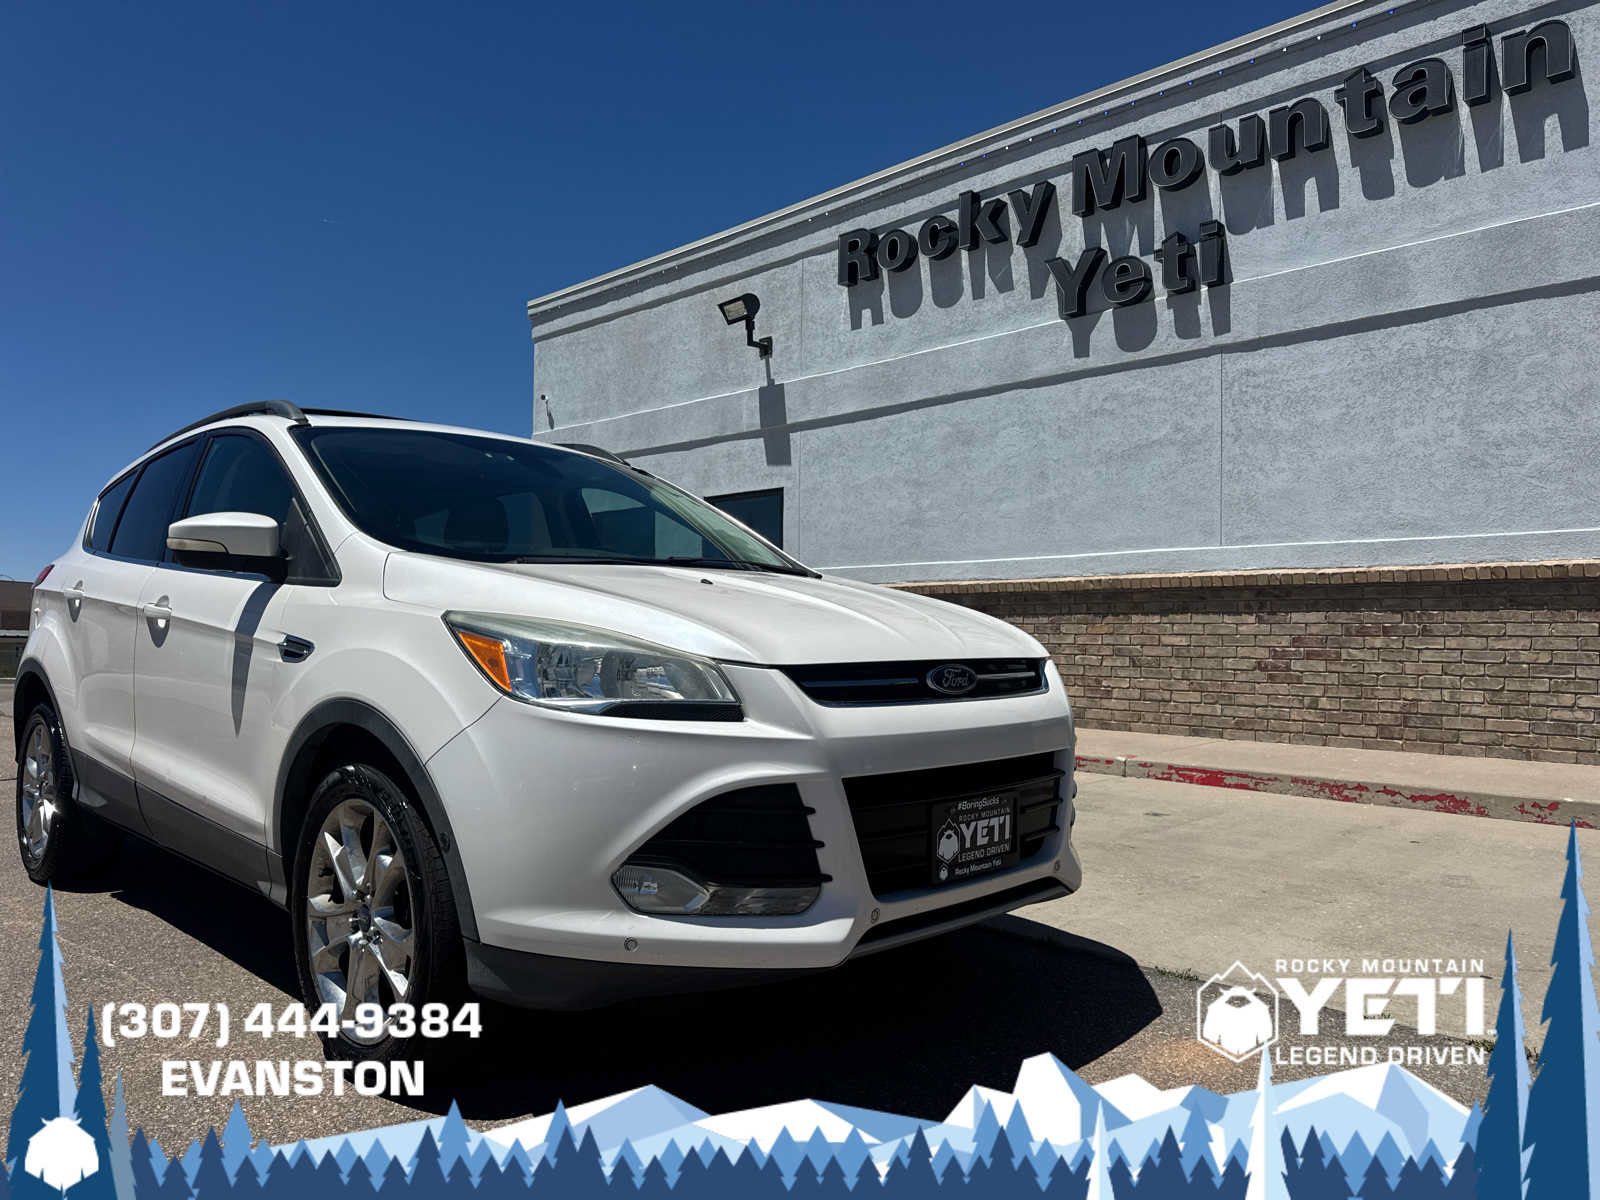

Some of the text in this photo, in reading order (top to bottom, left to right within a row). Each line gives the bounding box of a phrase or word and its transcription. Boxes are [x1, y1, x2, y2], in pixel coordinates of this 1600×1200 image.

[837, 19, 1576, 287] Rocky Mountain
[1046, 219, 1233, 318] Yeti
[942, 668, 969, 688] Ford
[959, 808, 1010, 822] ROCKY MOUNTAIN
[960, 814, 1010, 849] YETI
[958, 843, 1010, 863] LEGEND DRIVEN
[970, 862, 992, 872] Mountain
